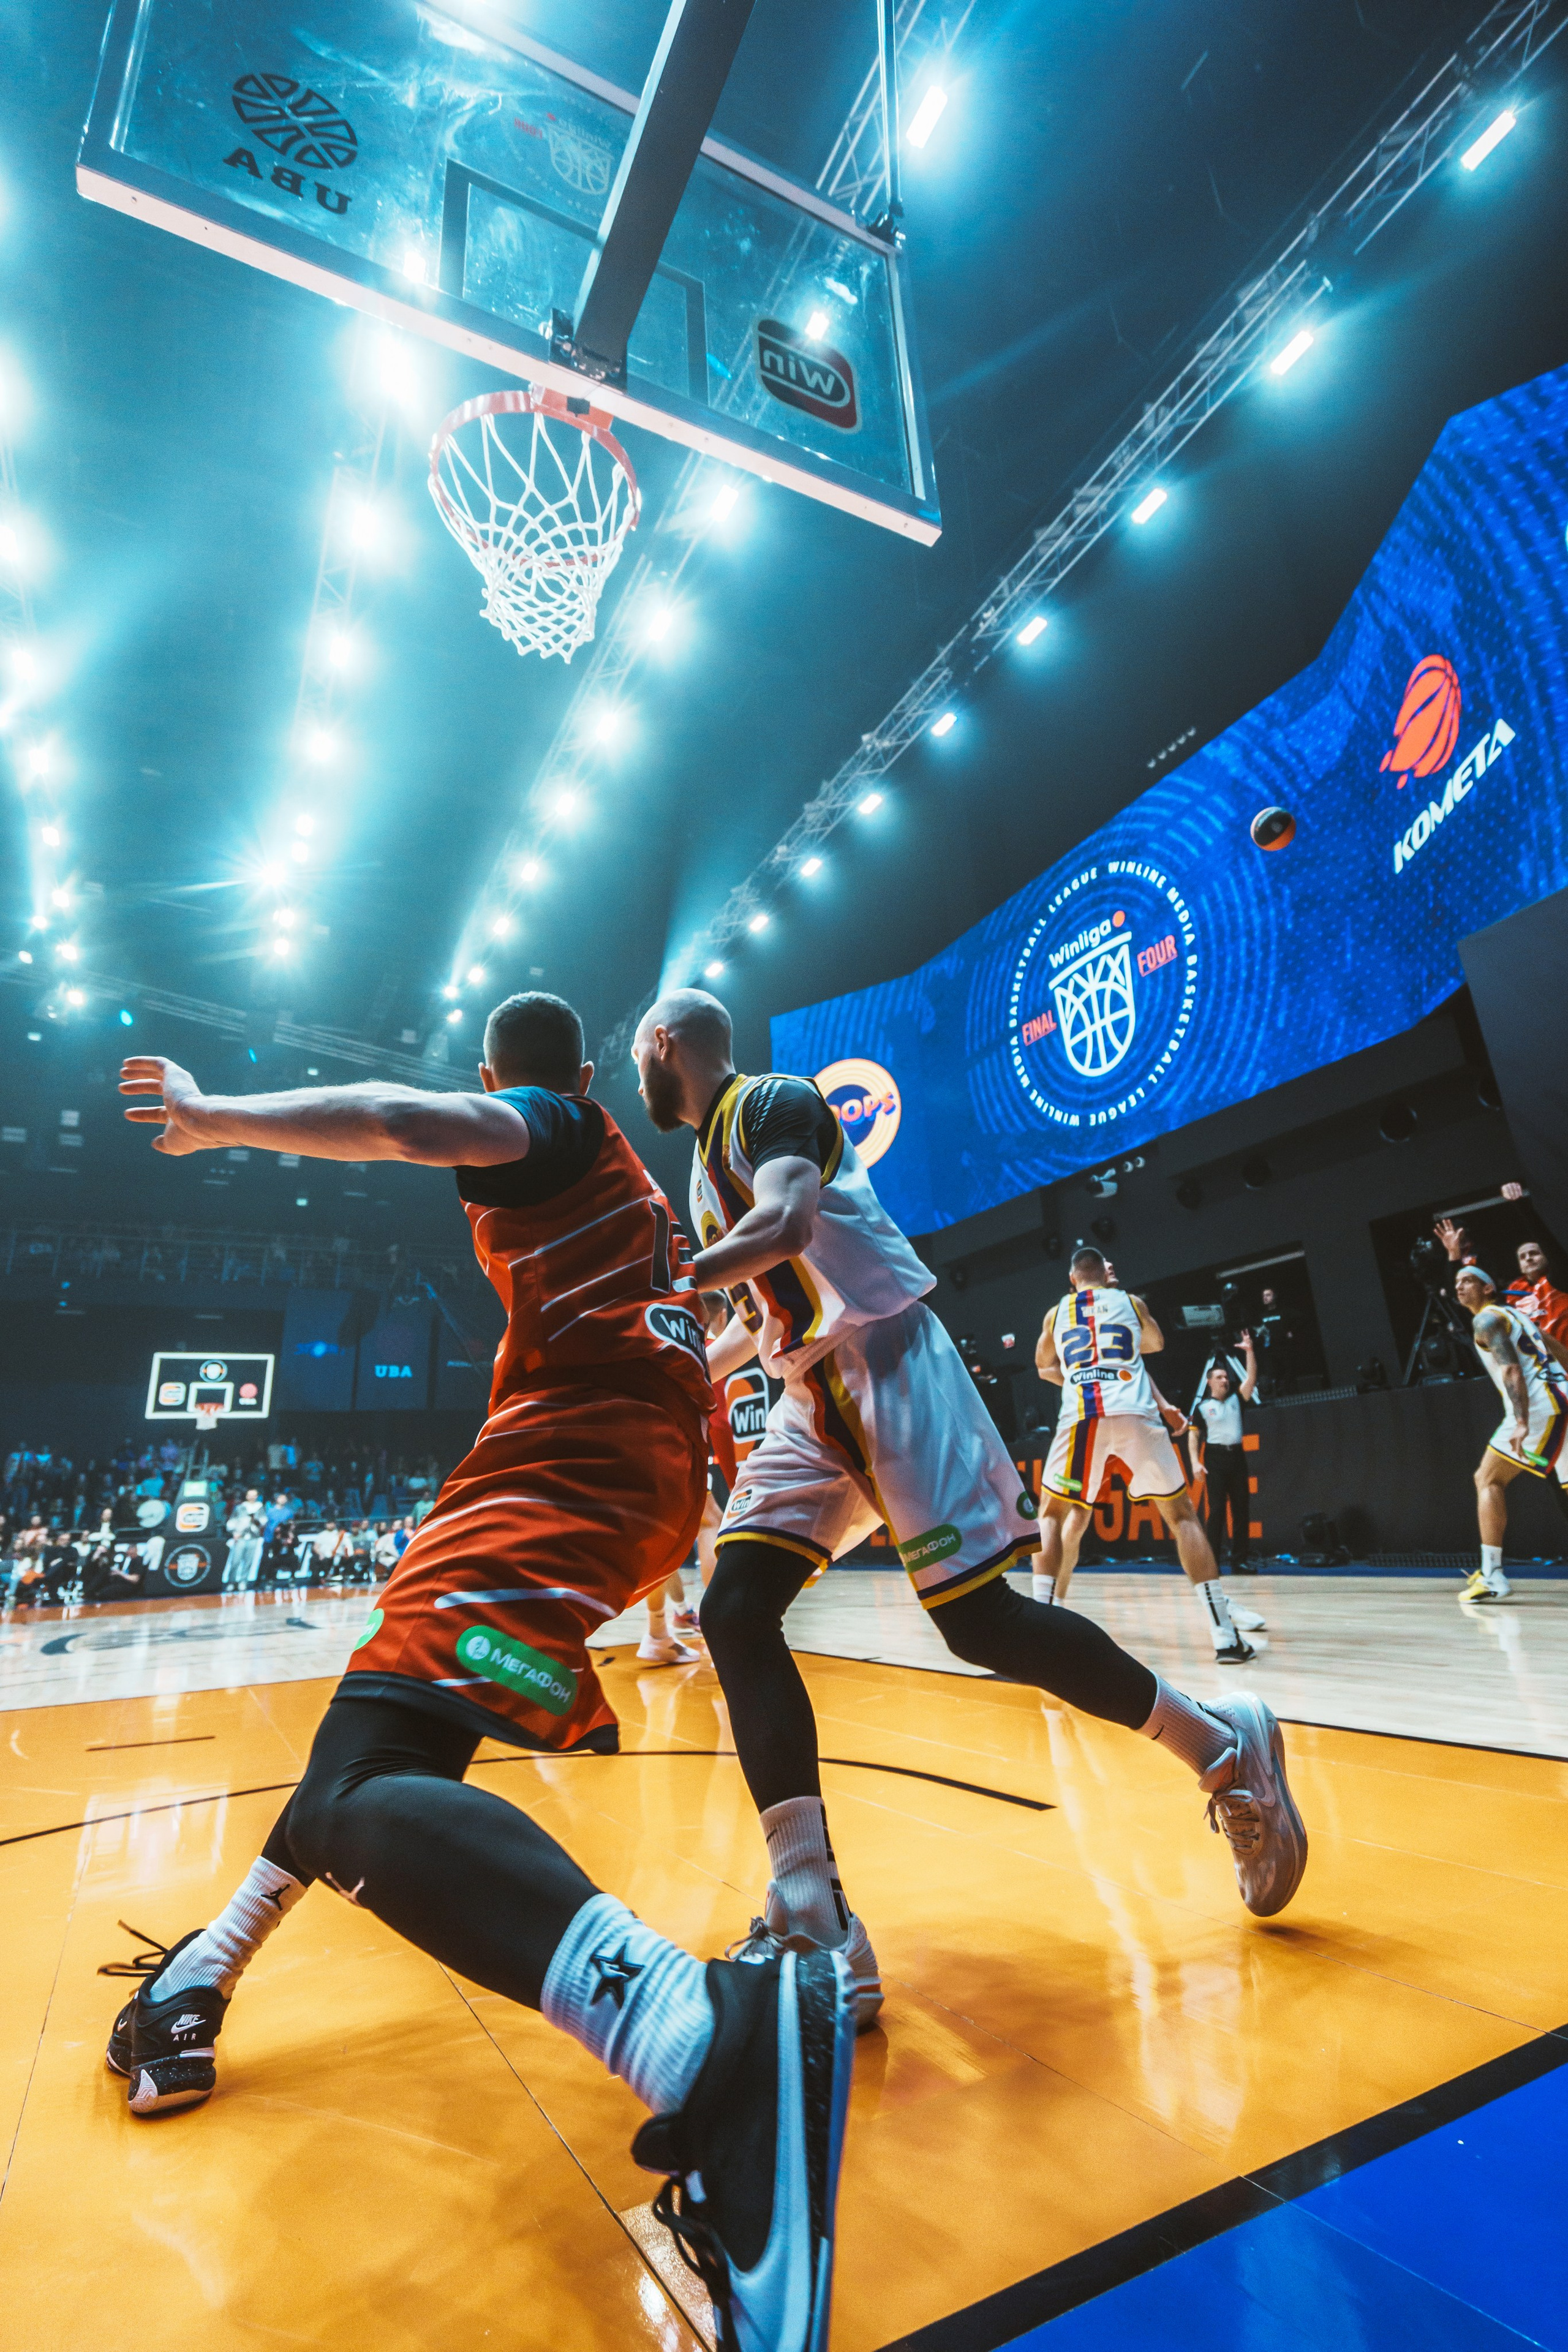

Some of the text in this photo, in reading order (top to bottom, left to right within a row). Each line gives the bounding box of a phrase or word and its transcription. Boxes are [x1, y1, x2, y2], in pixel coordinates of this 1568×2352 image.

[1048, 918, 1112, 969] Winliga
[1136, 933, 1179, 978] FOUR
[1008, 866, 1099, 1127] WINLINE MEDIA BASKETBALL LEAGUE
[1084, 861, 1199, 1128] WINLINE MEDIA BASKETBALL LEAGUE
[1021, 1009, 1058, 1047] FINAL
[1061, 1322, 1134, 1370] 23
[374, 1365, 413, 1378] UBA
[1071, 1366, 1115, 1384] Winline
[734, 1403, 766, 1434] Win
[173, 2033, 197, 2041] AIR
[176, 2014, 200, 2026] NIKE
